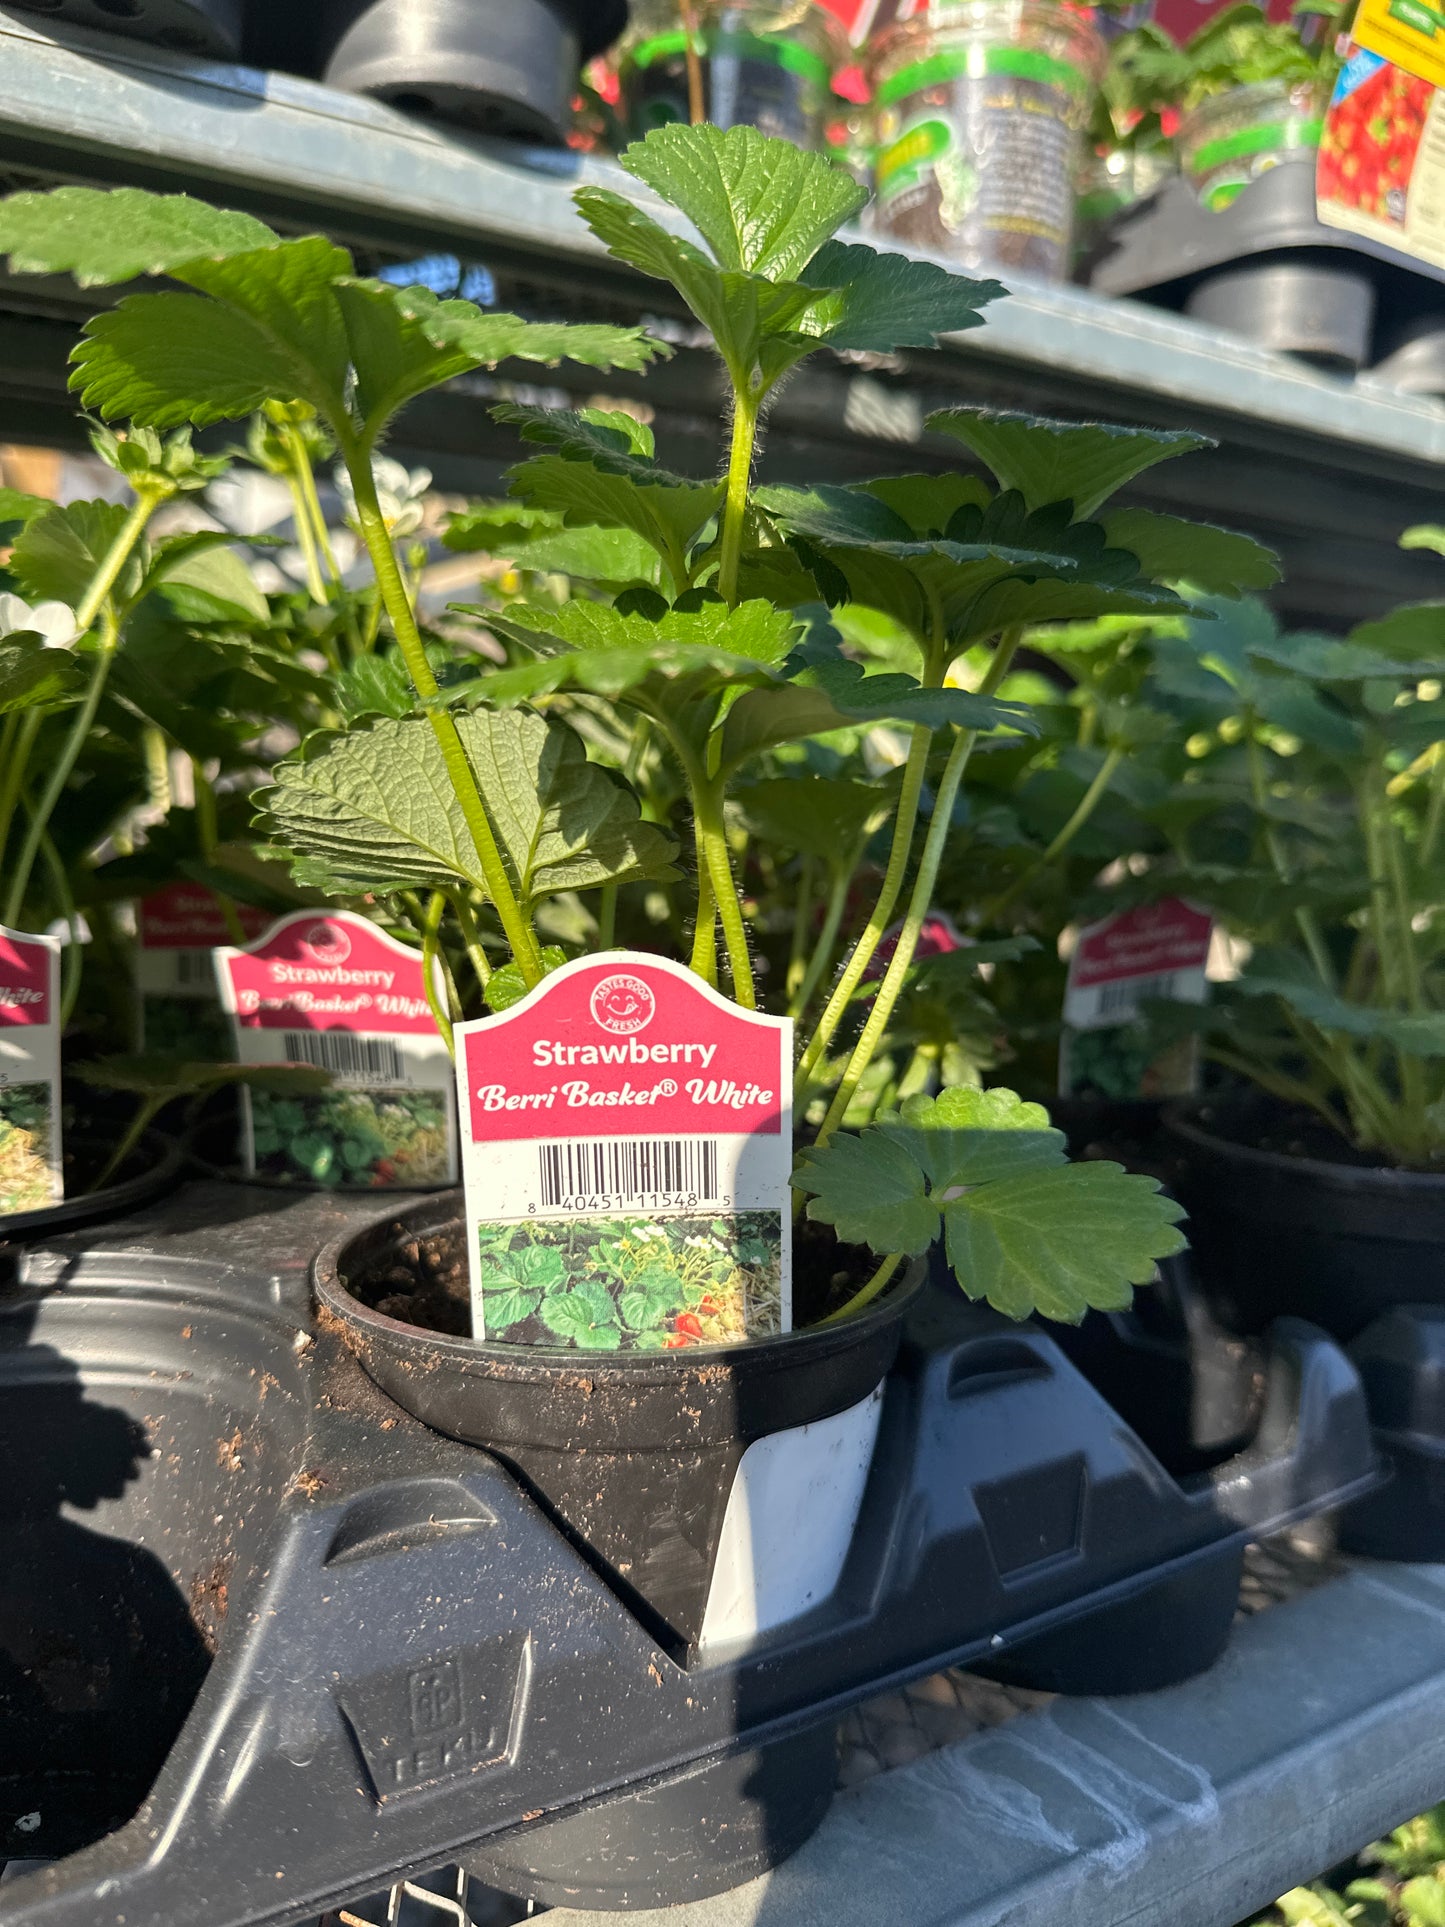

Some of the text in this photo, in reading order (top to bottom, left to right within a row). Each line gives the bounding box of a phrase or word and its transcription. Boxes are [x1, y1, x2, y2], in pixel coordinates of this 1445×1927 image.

[271, 961, 396, 990] Strawberry
[595, 979, 650, 1001] TASTES GOOD
[605, 1017, 641, 1031] FRESH
[532, 1037, 718, 1069] Strawberry
[477, 1084, 558, 1112] Berri
[684, 1078, 774, 1110] White
[527, 1192, 732, 1214] 8 40451 11548 5
